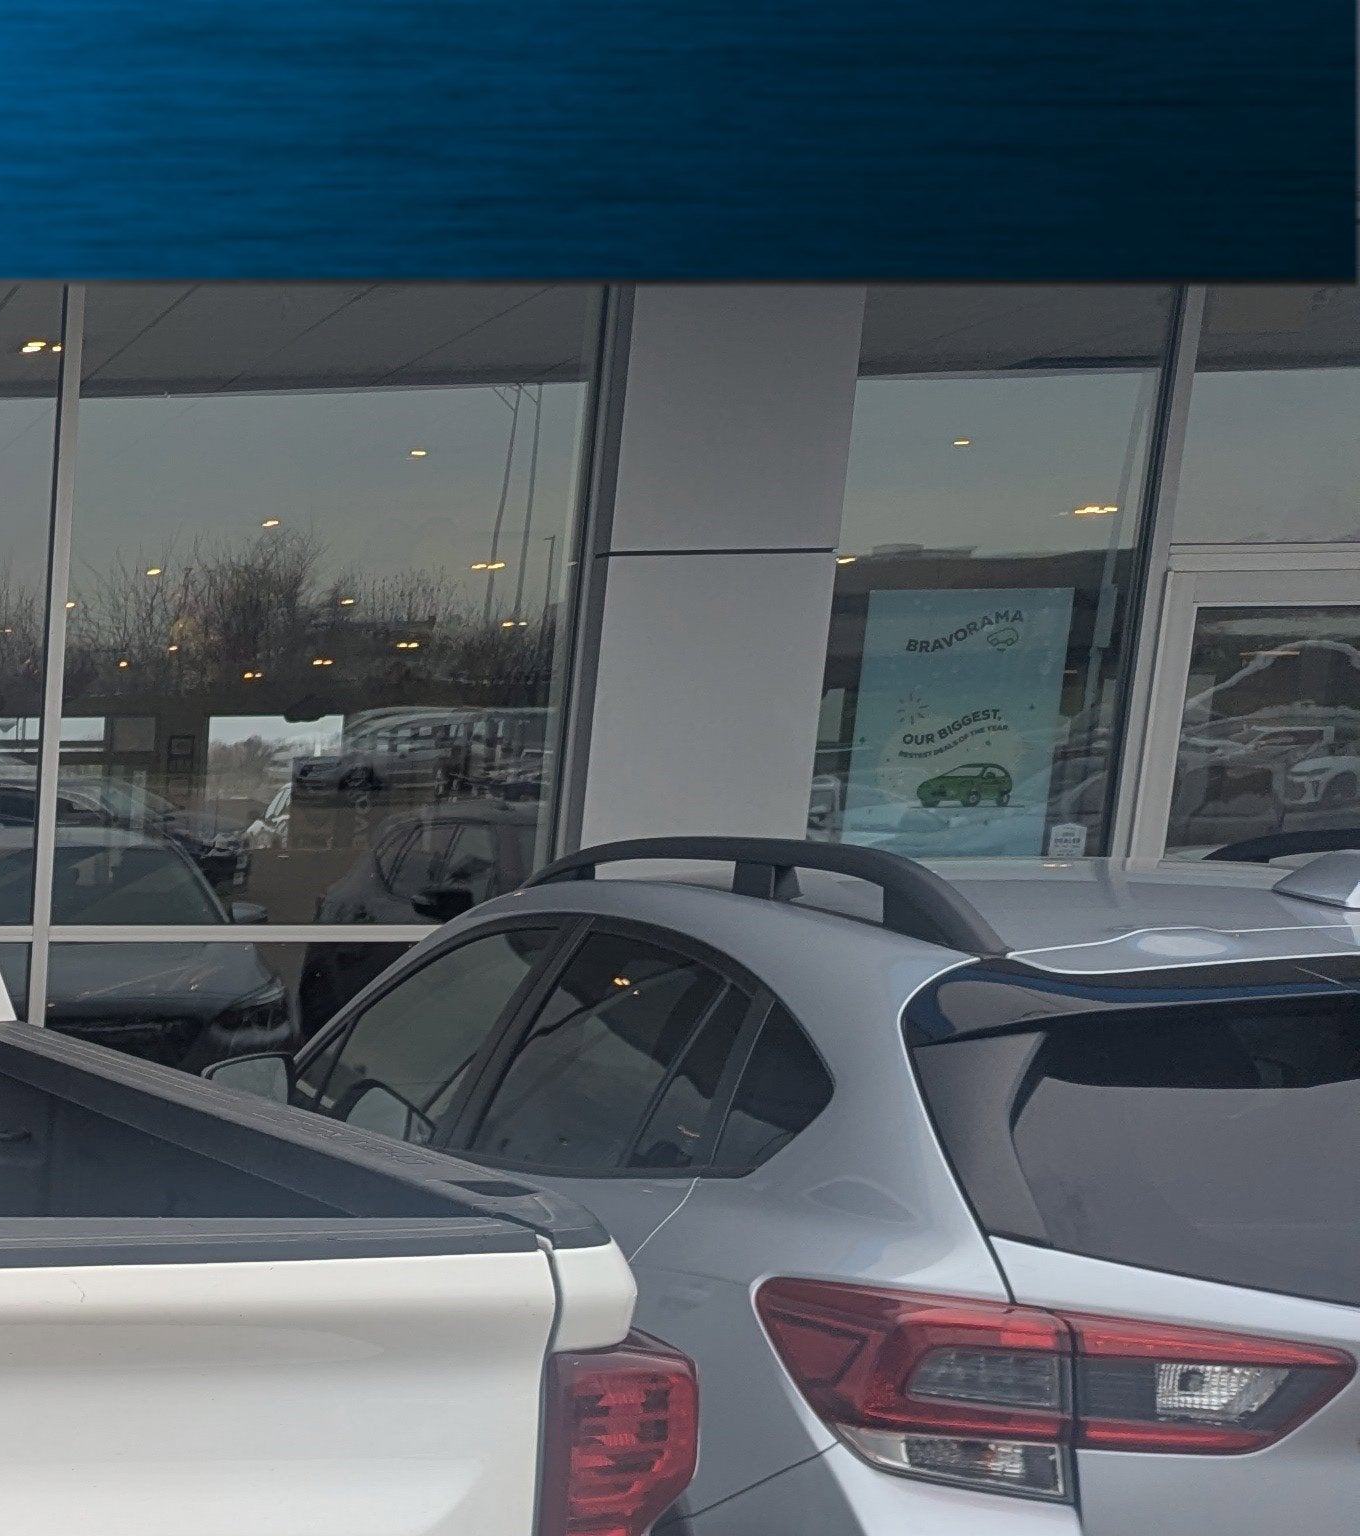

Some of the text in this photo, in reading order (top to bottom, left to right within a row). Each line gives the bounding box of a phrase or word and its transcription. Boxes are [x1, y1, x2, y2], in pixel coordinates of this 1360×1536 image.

[905, 609, 1025, 653] BRAVORAMA
[902, 708, 1003, 746] OUR BIGGEST,
[969, 726, 986, 737] THE
